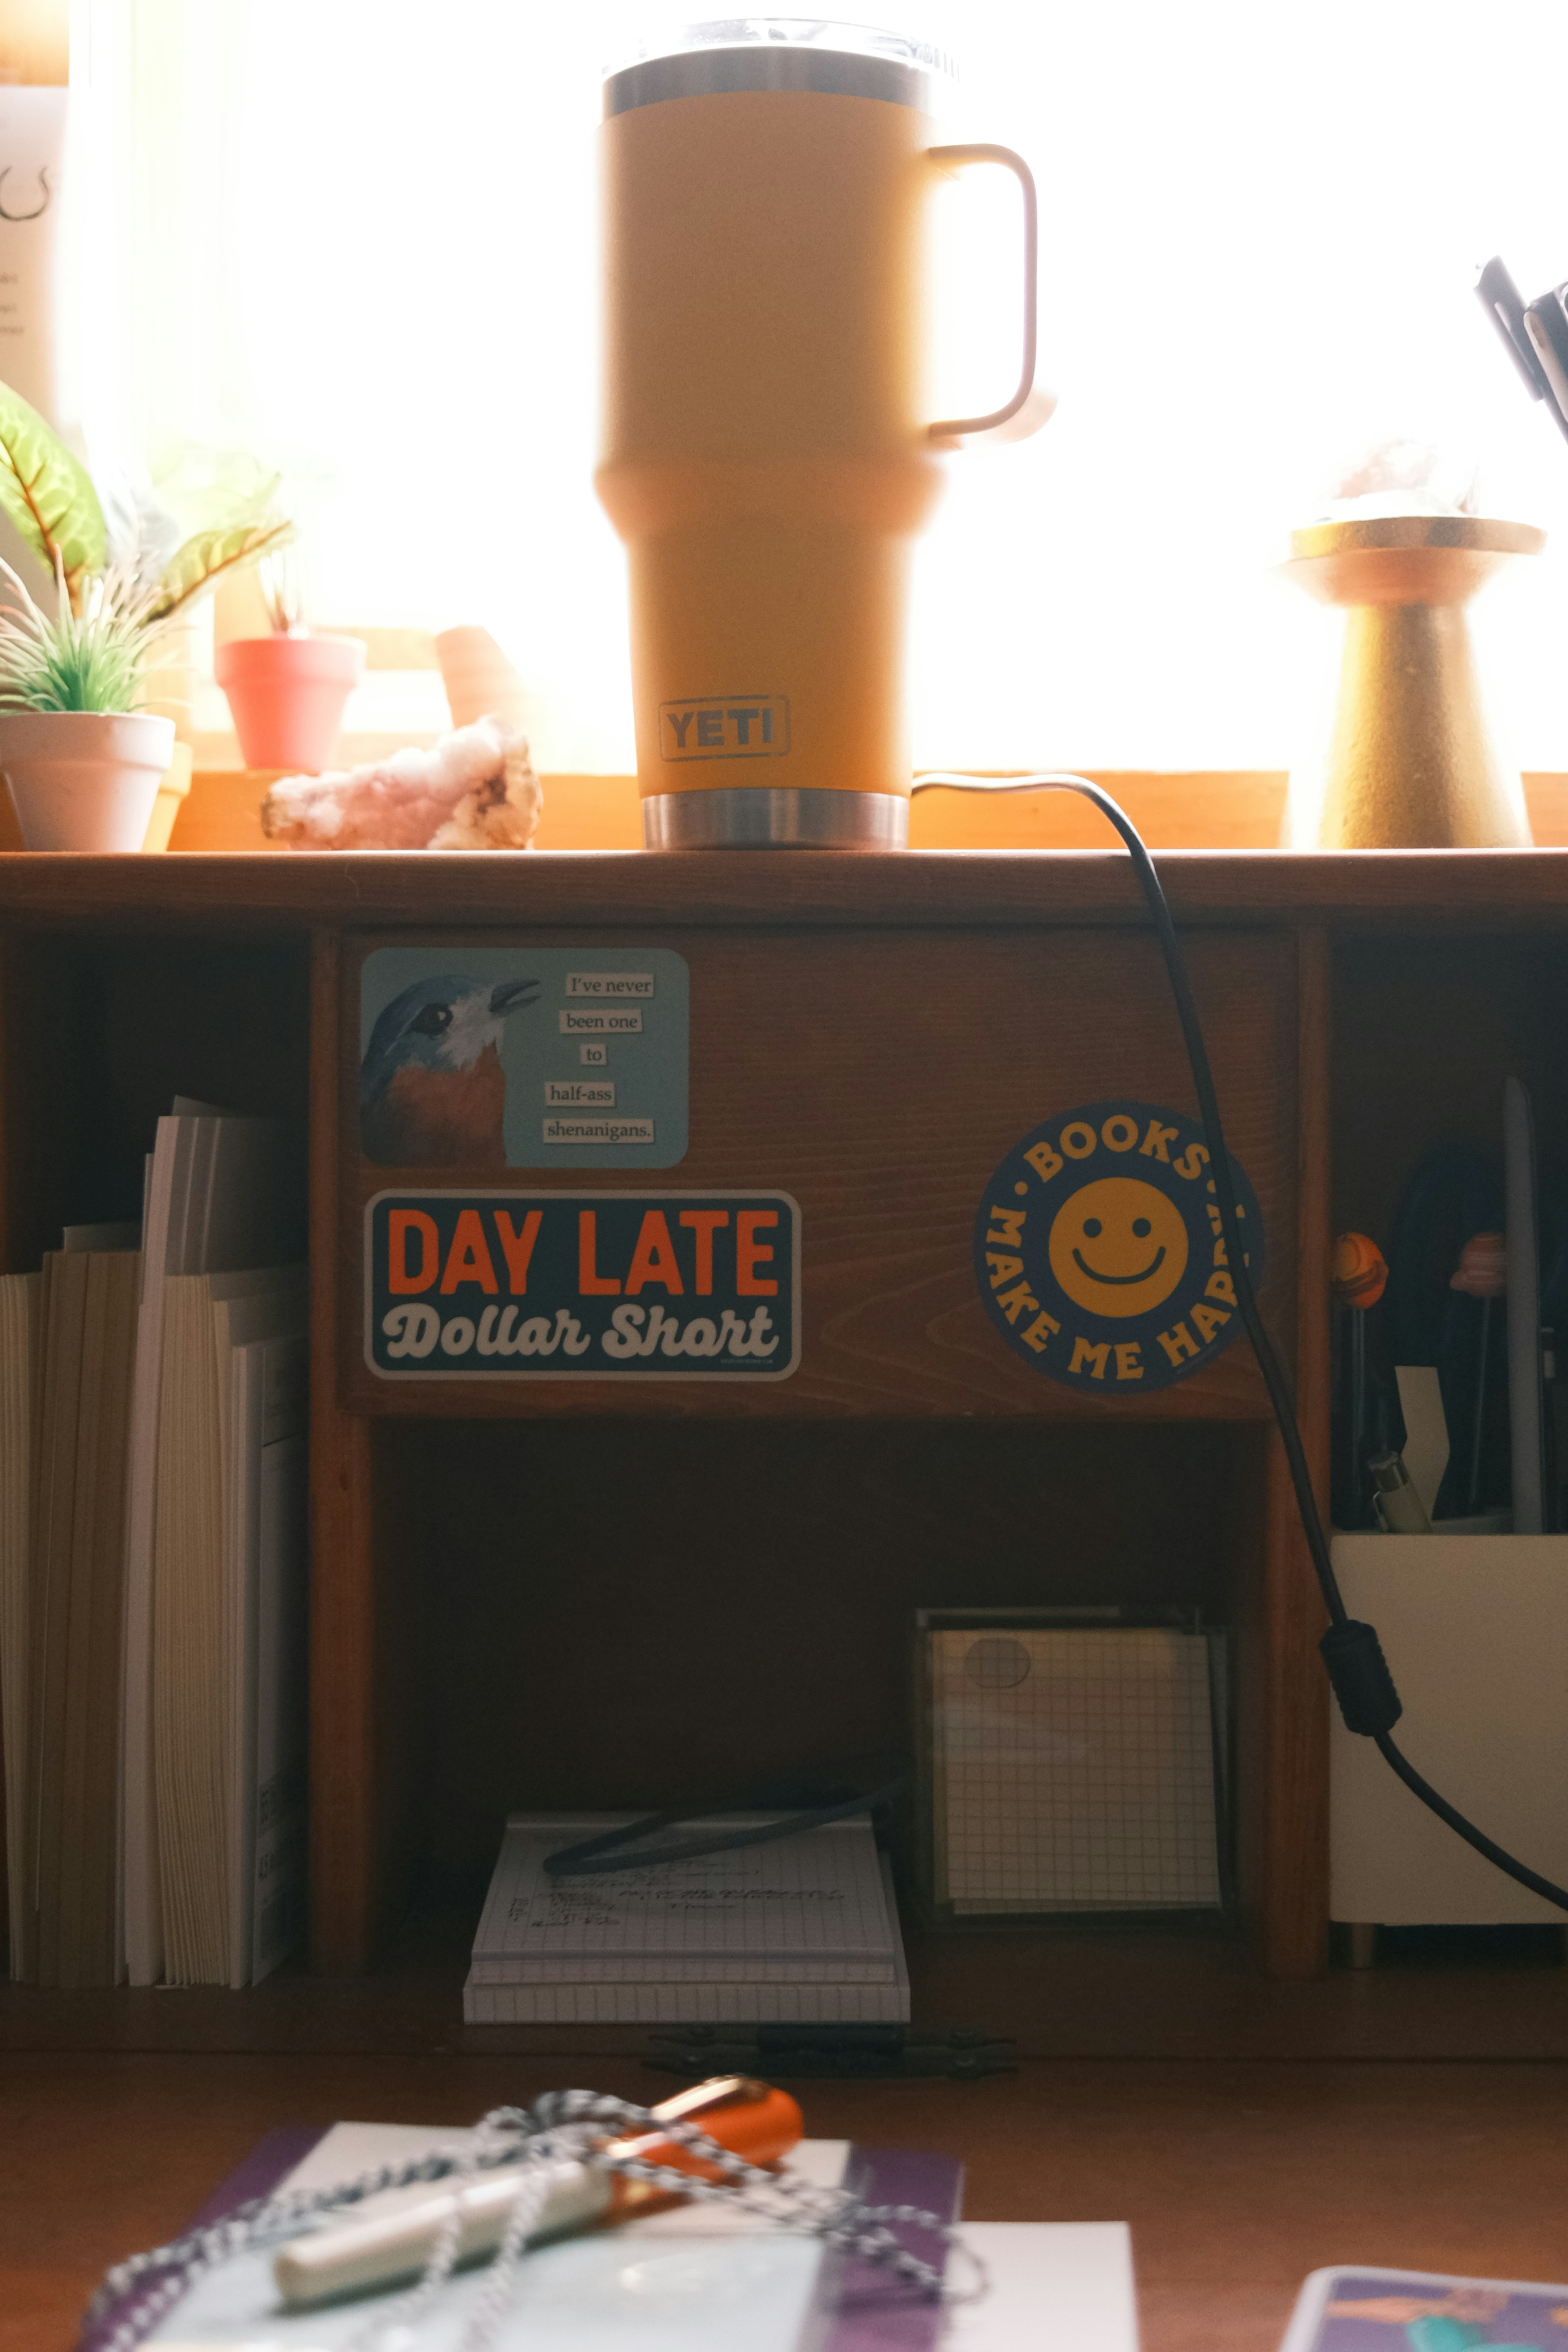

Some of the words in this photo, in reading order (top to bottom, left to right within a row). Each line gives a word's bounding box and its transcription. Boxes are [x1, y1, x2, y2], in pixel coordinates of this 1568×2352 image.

[666, 708, 773, 748] YETI
[571, 977, 601, 992] I've
[606, 983, 651, 992] never
[567, 1013, 604, 1028] been
[609, 1018, 638, 1028] one
[586, 1049, 602, 1061] to
[551, 1085, 612, 1101] half-ass
[548, 1121, 651, 1141] shenanigans.
[1023, 1115, 1210, 1182] BOOKS
[388, 1209, 543, 1295] DAY
[579, 1210, 779, 1296] LATE
[985, 1205, 1061, 1354] MAKE
[1067, 1337, 1144, 1380] ME
[381, 1302, 591, 1358] Dollar
[602, 1303, 779, 1358] Short
